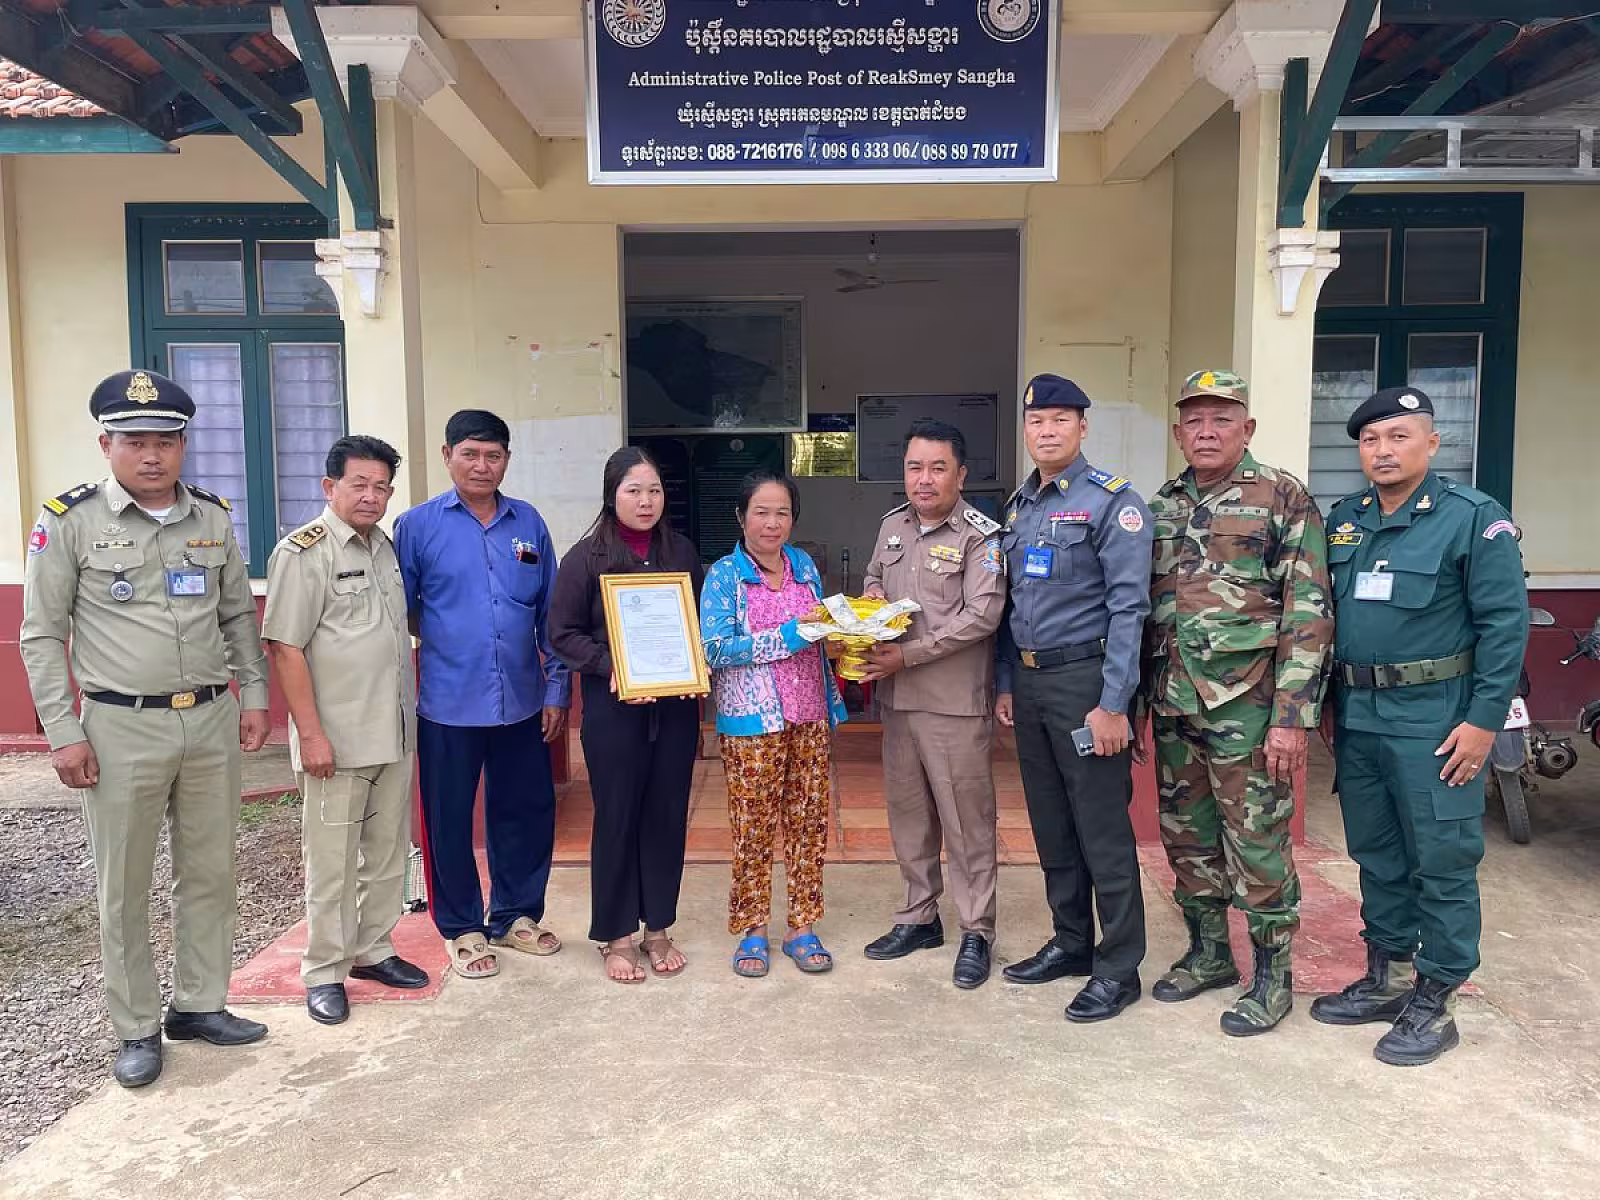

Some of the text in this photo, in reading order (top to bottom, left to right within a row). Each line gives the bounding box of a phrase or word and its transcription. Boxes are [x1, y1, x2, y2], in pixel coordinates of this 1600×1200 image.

[628, 67, 1017, 89] Administrative Police Post of ReakSmey Sangha
[707, 142, 804, 161] 088-7216176
[822, 142, 848, 159] 098
[851, 142, 860, 159] 6
[863, 142, 889, 159] 333
[951, 143, 968, 160] 89
[972, 143, 989, 160] 79
[992, 143, 1018, 160] 077
